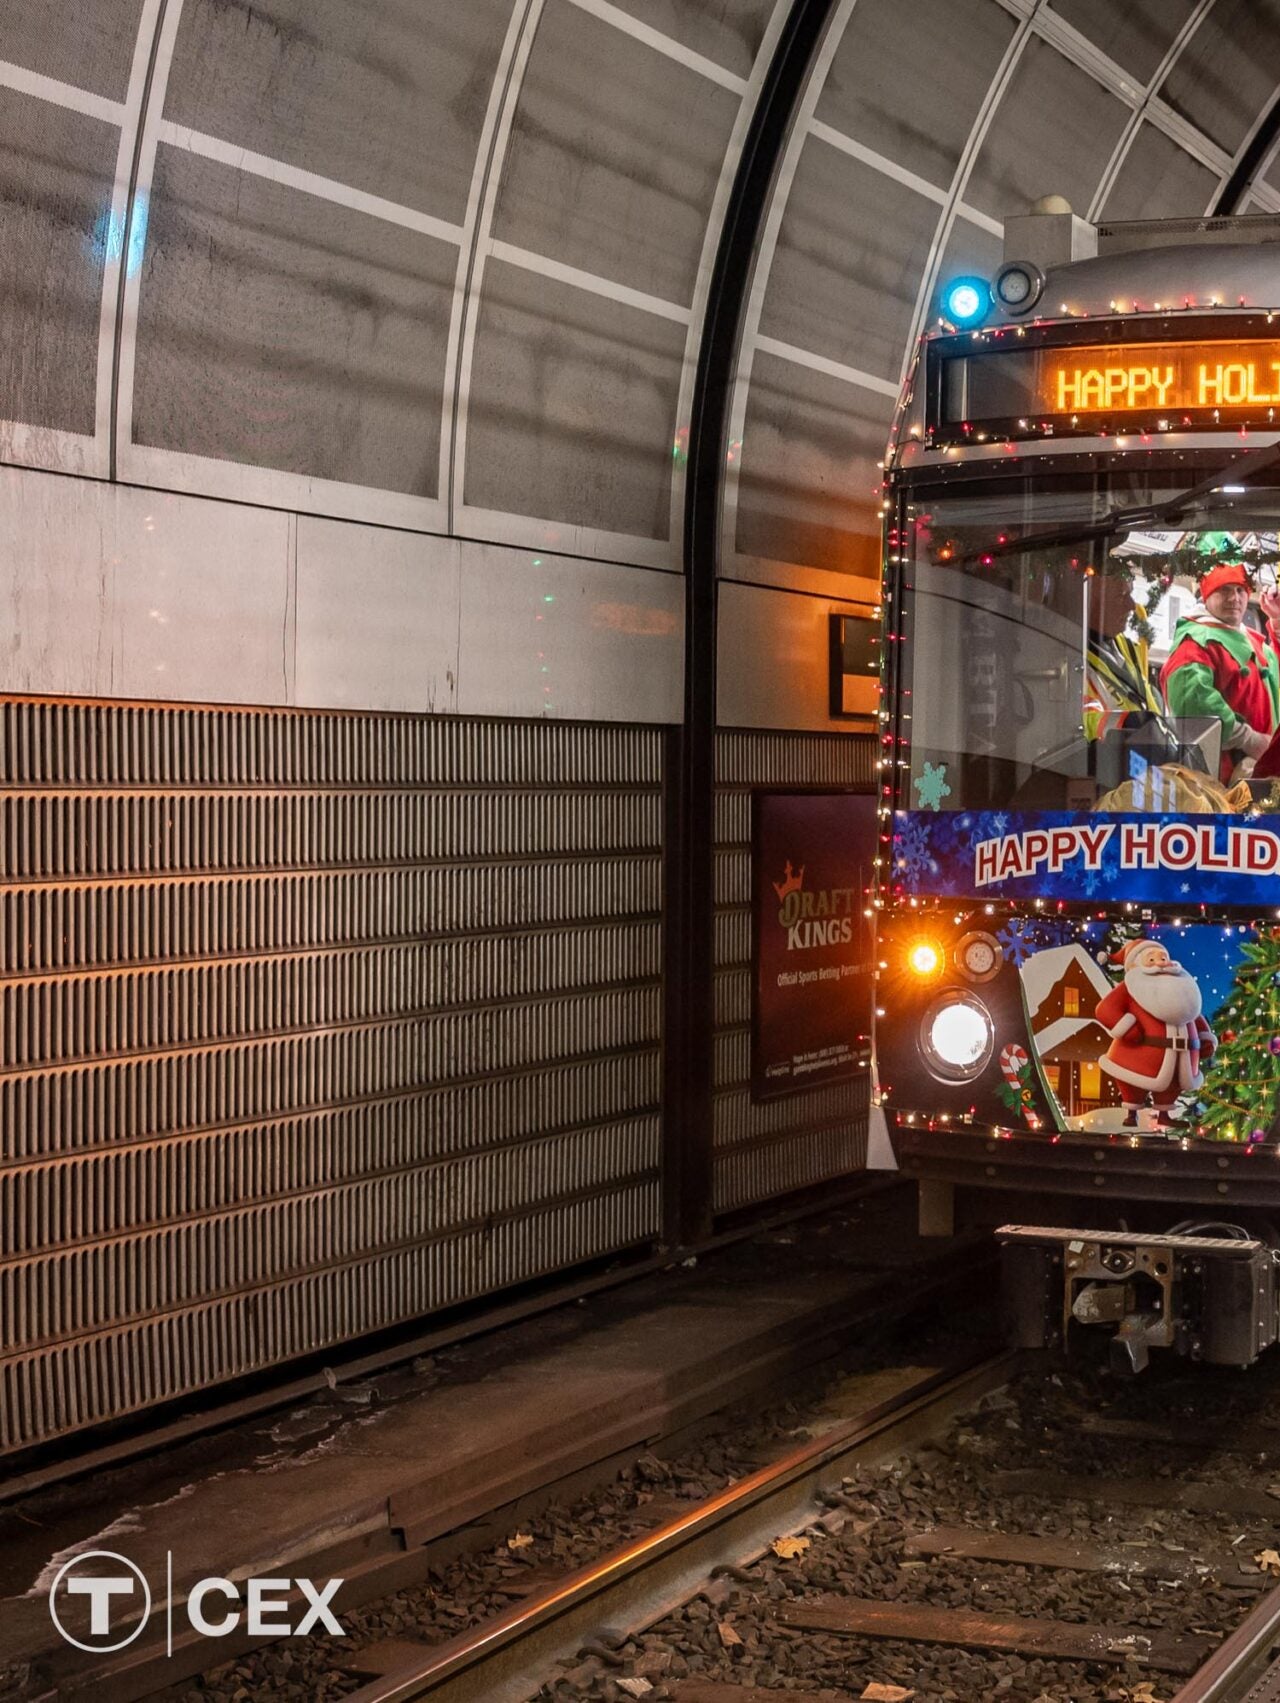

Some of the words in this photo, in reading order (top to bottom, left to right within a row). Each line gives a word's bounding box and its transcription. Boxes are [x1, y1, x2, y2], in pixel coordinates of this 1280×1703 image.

[1057, 367, 1174, 409] HAPPY
[975, 824, 1116, 887] HAPPY
[778, 888, 855, 928] DRAFT
[787, 917, 853, 951] KINGS
